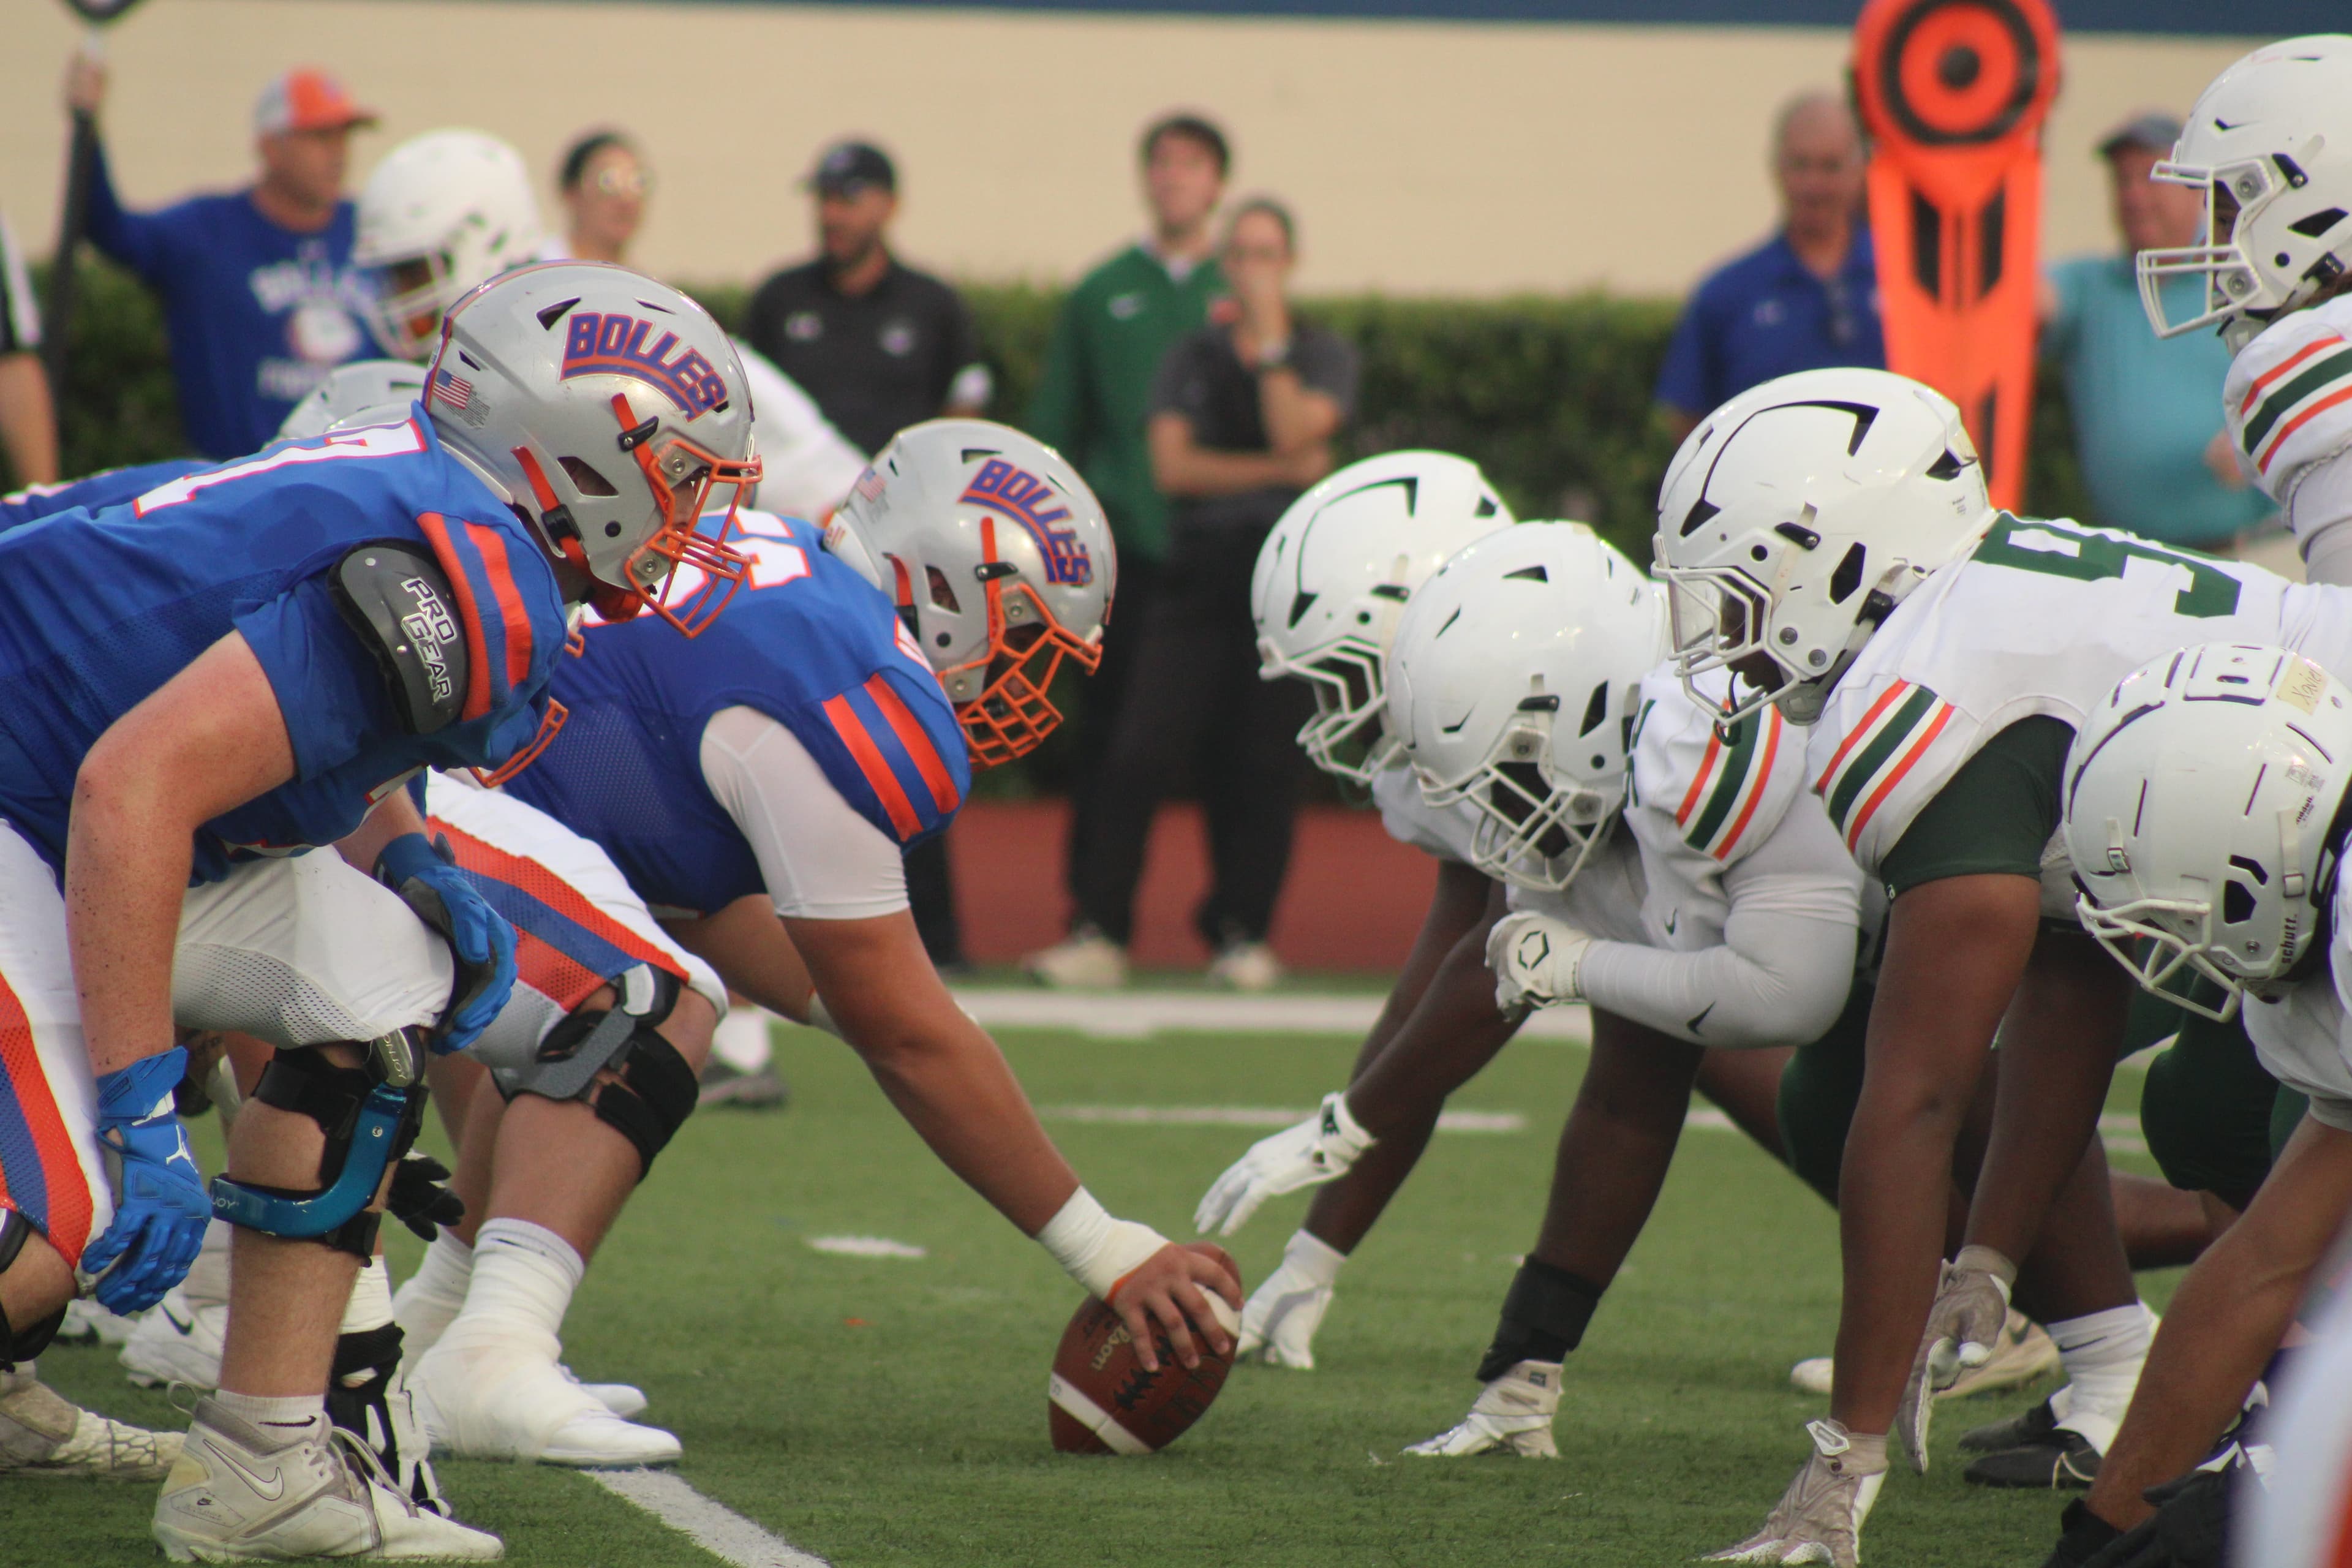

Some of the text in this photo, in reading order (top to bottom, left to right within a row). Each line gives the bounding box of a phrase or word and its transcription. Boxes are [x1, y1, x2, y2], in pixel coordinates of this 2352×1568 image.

[563, 312, 728, 423] BOLLES
[969, 458, 1094, 586] BOLLES
[401, 576, 458, 644] PRO
[401, 612, 452, 705] GEAR
[383, 1033, 407, 1079] ONJOY
